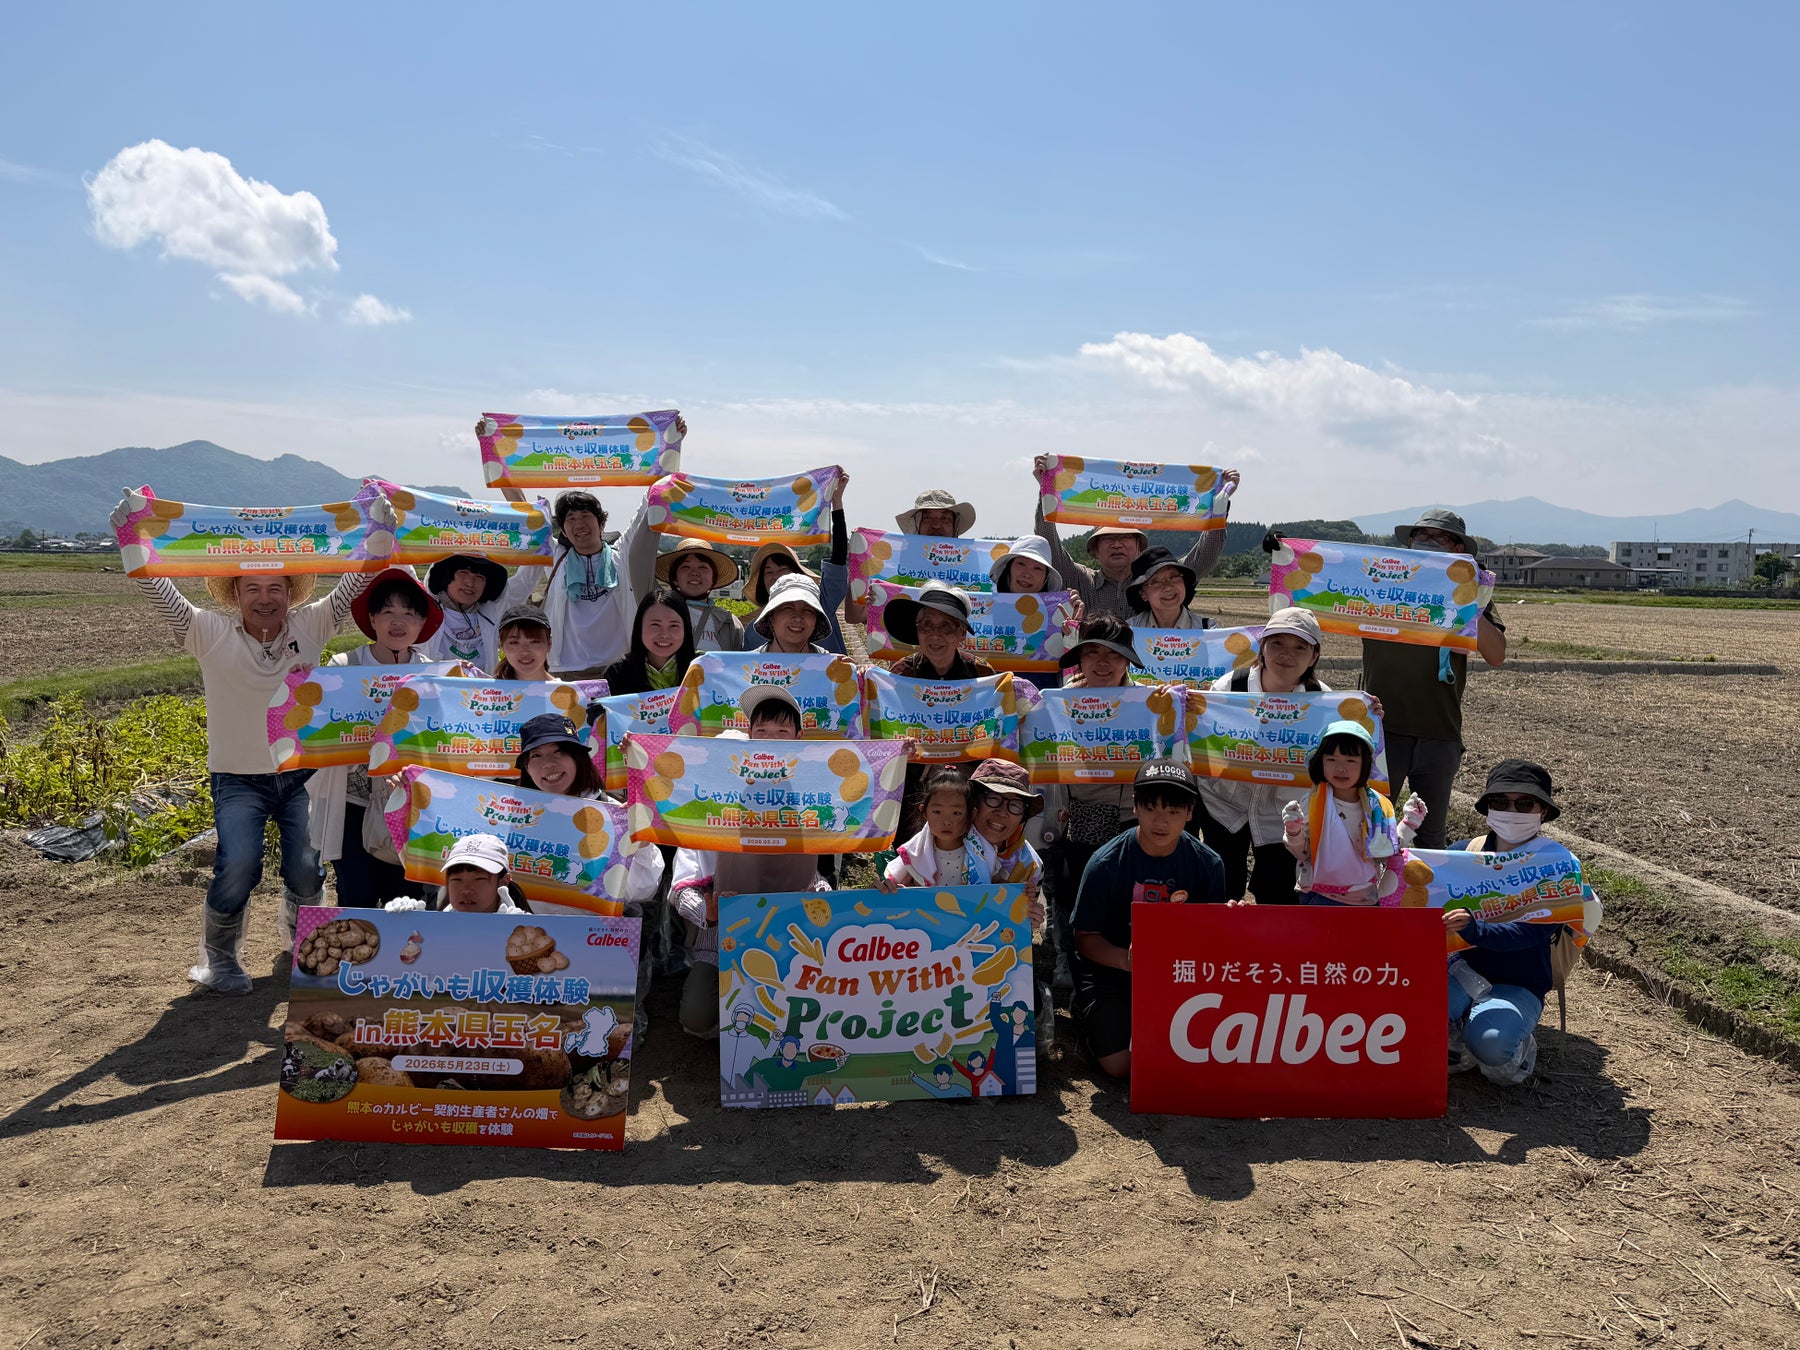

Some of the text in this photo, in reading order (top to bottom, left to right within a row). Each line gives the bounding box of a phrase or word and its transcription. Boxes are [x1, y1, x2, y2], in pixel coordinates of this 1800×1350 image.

[564, 428, 598, 437] Project
[1123, 465, 1157, 475] Project
[733, 492, 764, 500] Project
[192, 521, 327, 535] じゃがいも収穫体験
[207, 539, 315, 555] in熊本県玉名
[929, 553, 961, 562] Project
[1368, 568, 1409, 580] Project
[1327, 579, 1445, 605] じゃがいも収穫体験
[1334, 601, 1431, 623] in熊本県玉名
[1153, 647, 1191, 657] Project
[770, 668, 790, 676] With!
[1130, 665, 1226, 676] ゃがいも収穫体験
[922, 694, 962, 703] Project
[469, 701, 513, 712] Project
[1071, 708, 1111, 718] Project
[884, 707, 995, 724] じゃがいも収穫体験
[1255, 708, 1299, 720] Project
[1034, 727, 1150, 741] じゃがいも収穫体験
[438, 737, 522, 754] in熊本県玉
[1046, 746, 1141, 761] in熊本県玉名
[1224, 744, 1306, 764] in熊本県玉
[744, 760, 785, 768] Fan With!
[740, 767, 788, 778] Project
[1160, 766, 1186, 777] LOGOS
[501, 797, 522, 806] Calbee
[694, 784, 832, 806] じゃがいも収穫体験
[490, 802, 506, 811] Fan
[484, 807, 532, 823] Project
[707, 809, 820, 828] in熊本県玉名
[1474, 879, 1580, 920] n熊本県玉名
[587, 933, 628, 946] Calbee
[838, 937, 919, 962] Calbee
[794, 956, 966, 996] Fan With!
[1173, 960, 1410, 986] 掘りだそう、自然の力。
[338, 960, 591, 1004] じゃがいも収穫体験
[785, 985, 974, 1040] Project
[355, 1009, 561, 1049] in熊本県玉名
[1170, 993, 1406, 1065] Calbee
[348, 1102, 557, 1120] 熊本のカルビー契約生産者さんの畑で
[392, 1120, 514, 1135] じゃがいも収穫を体験
